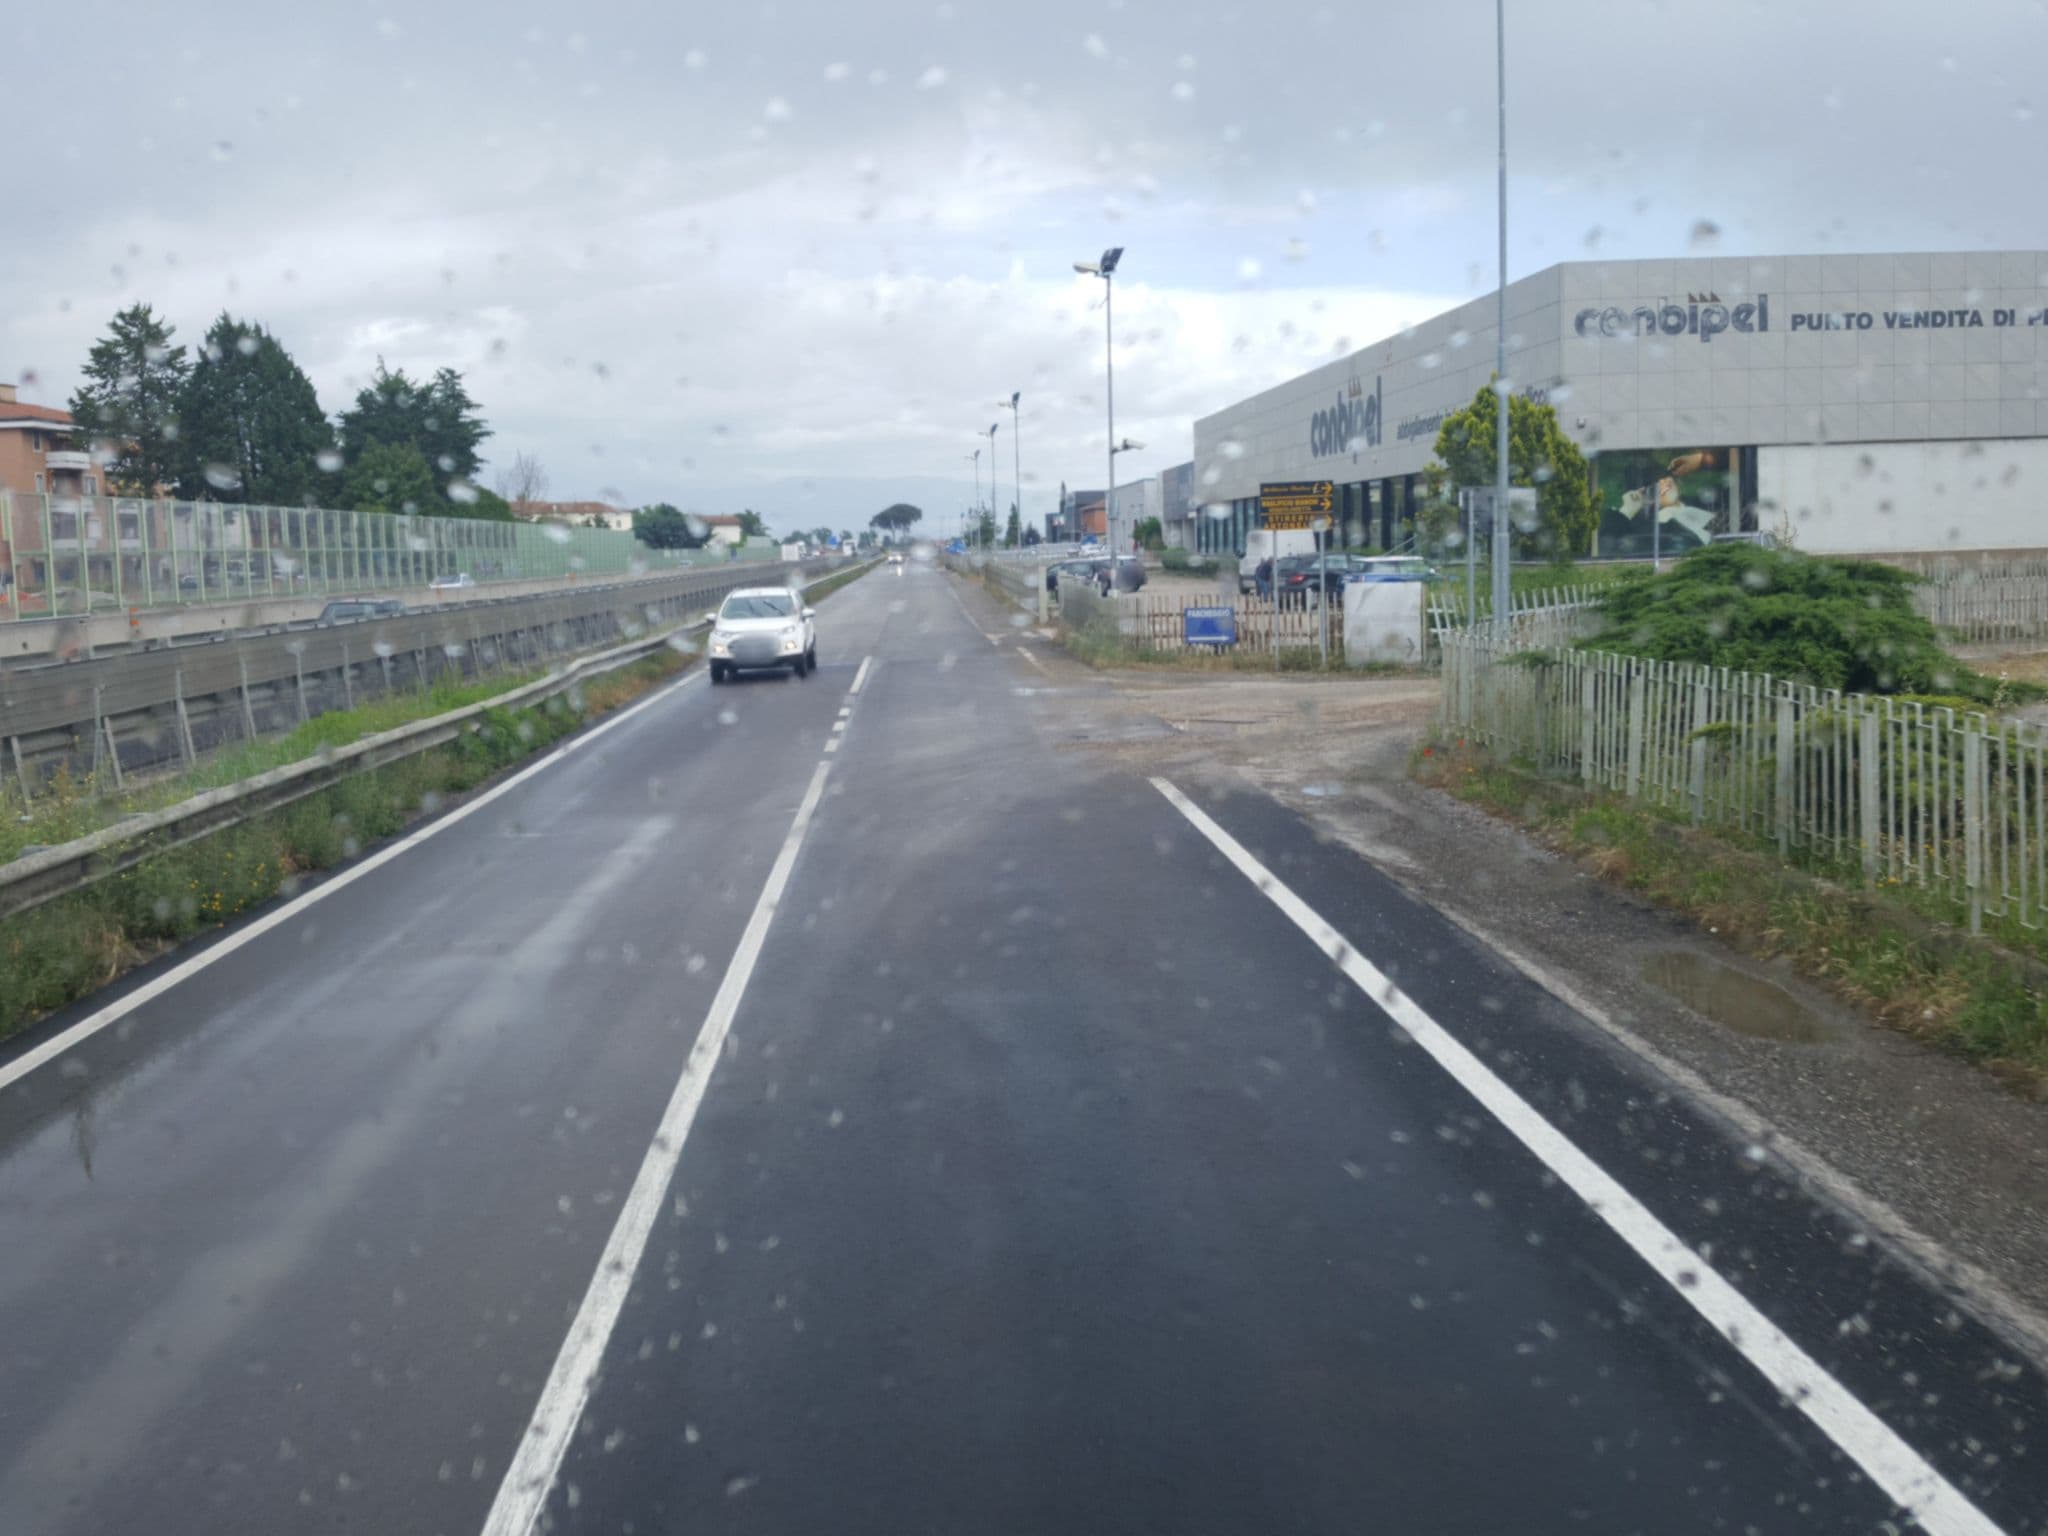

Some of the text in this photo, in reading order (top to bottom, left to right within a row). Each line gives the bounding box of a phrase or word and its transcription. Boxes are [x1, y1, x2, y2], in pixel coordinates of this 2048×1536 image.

[1574, 292, 1769, 342] conbipel
[1791, 312, 1873, 332] PUNTO
[1883, 309, 1984, 330] VENDITA
[1993, 308, 2016, 327] DI
